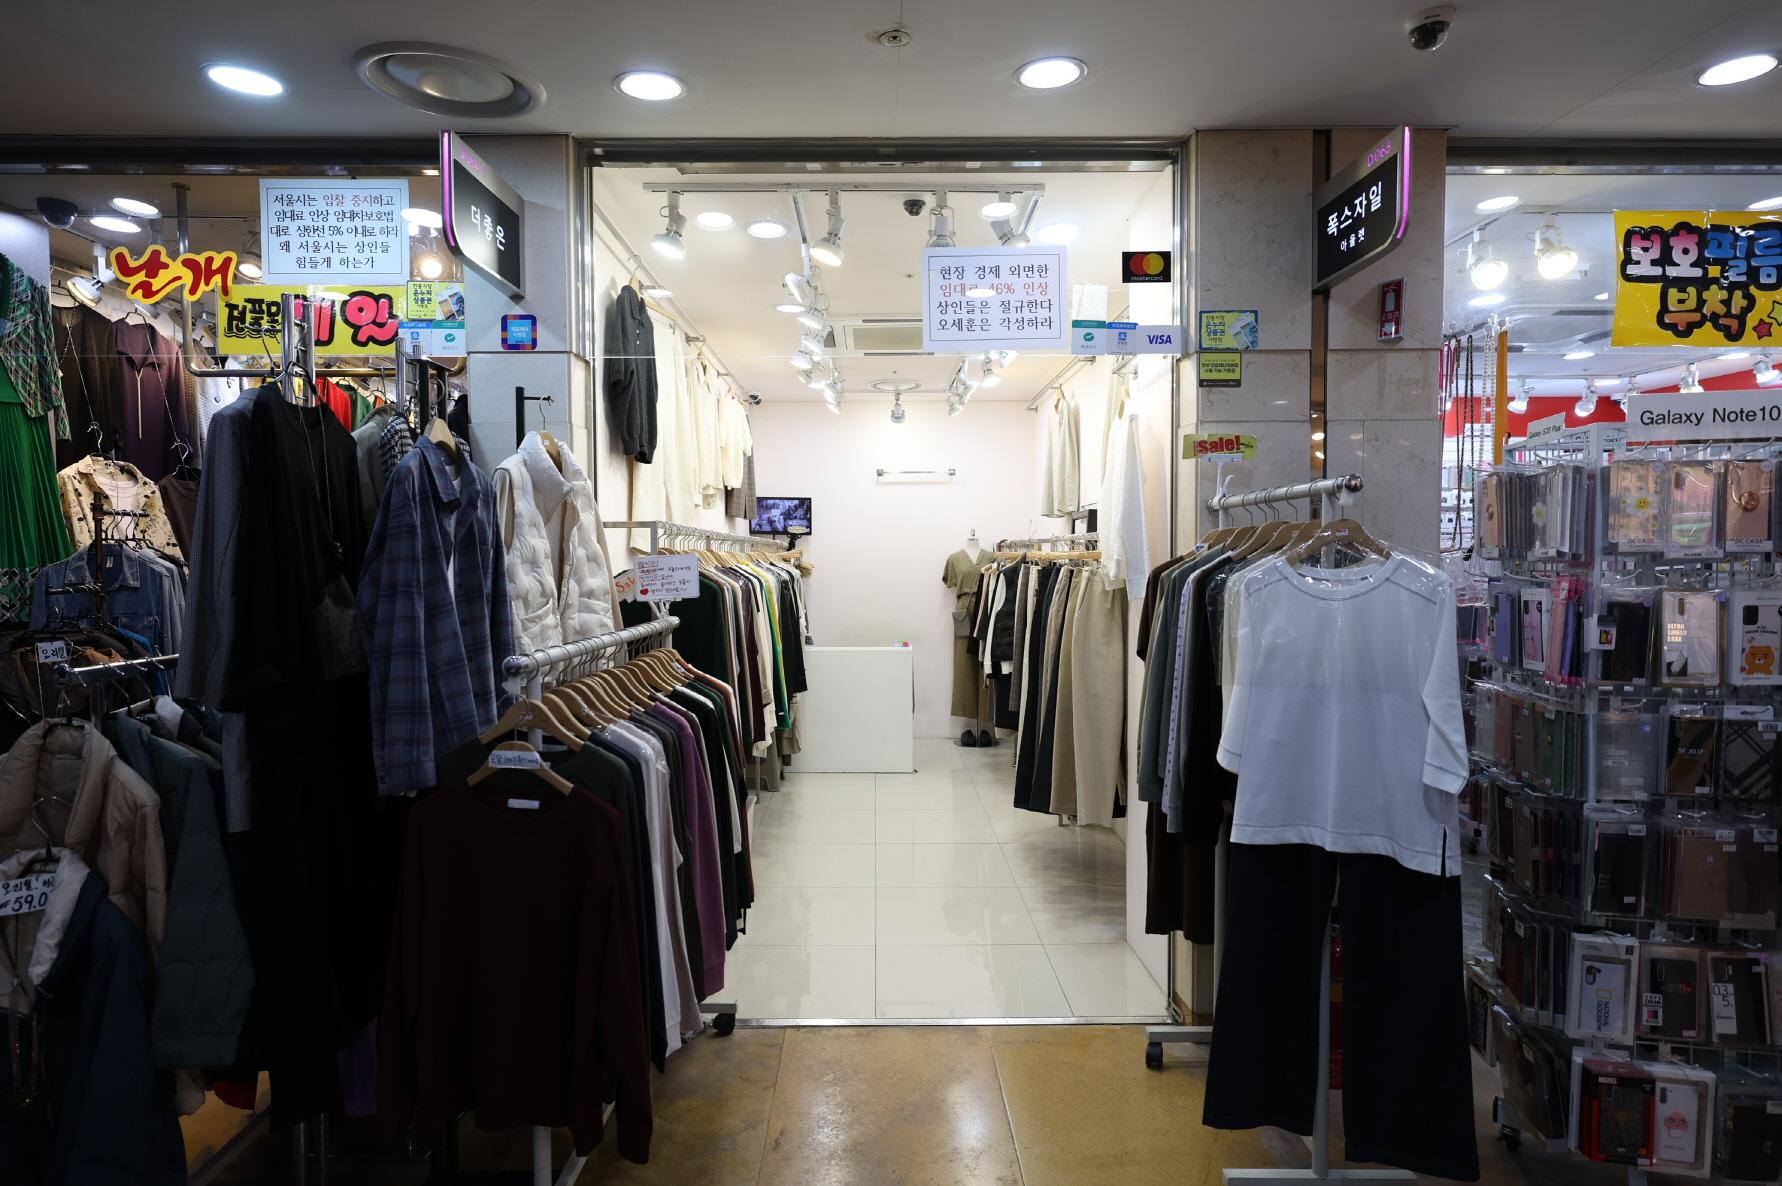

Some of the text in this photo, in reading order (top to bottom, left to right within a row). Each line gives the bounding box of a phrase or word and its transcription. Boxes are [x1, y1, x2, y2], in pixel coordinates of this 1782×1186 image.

[273, 193, 318, 207] 서울시는
[351, 194, 395, 207] 중지하고
[274, 209, 394, 223] 임대료 인상 임대차보호법
[1326, 181, 1383, 237] 폭스자일
[270, 225, 400, 238] 대로 상한선 5% 이내로 하라
[1340, 227, 1365, 252] 아울렛
[279, 240, 391, 254] 왜 서울시는 상인들
[296, 256, 376, 269] 힘들게 하는가
[113, 248, 234, 300] 날개
[939, 263, 1050, 280] 현장 경제 외면한
[1023, 281, 1050, 296] 인상
[936, 298, 1054, 316] 상인들은 절규한다
[1662, 284, 1752, 339] 부착
[936, 316, 1054, 332] 오세훈은 각성하라
[1147, 334, 1172, 344] VISA
[1640, 405, 1781, 429] Galaxy Note10
